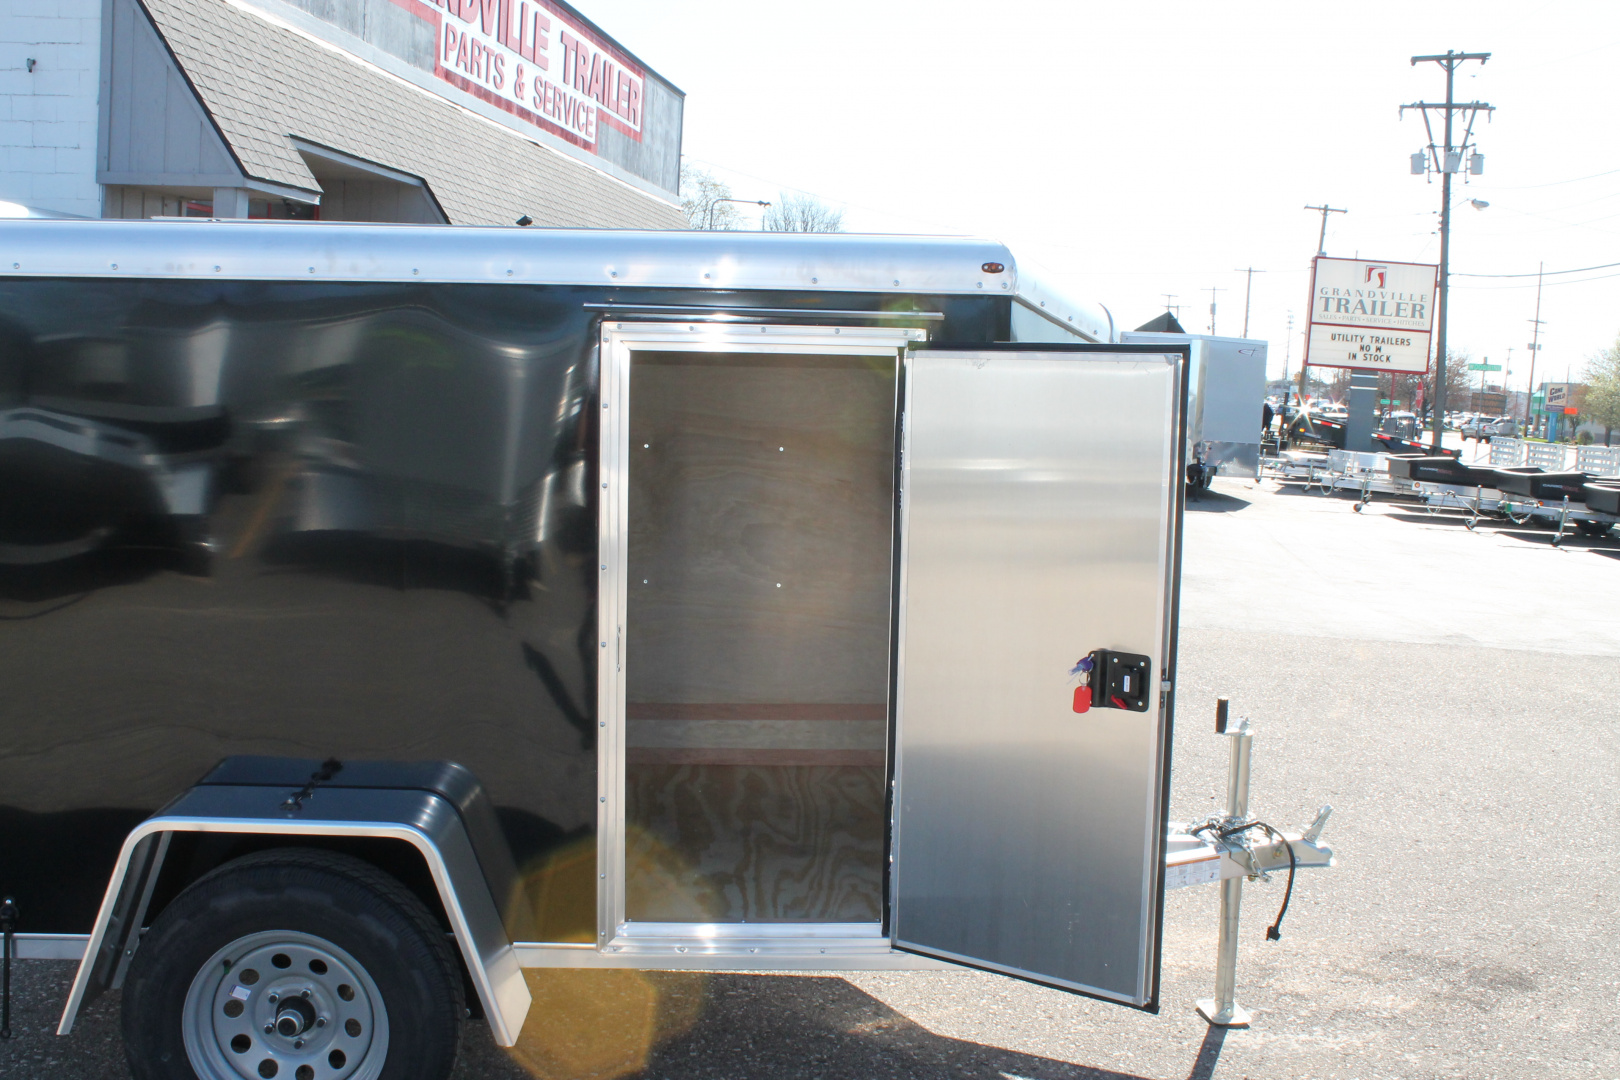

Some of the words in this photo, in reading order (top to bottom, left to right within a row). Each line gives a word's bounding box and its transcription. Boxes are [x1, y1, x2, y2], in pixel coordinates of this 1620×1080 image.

[444, 22, 505, 90] PARTS
[514, 62, 526, 101] &
[533, 75, 595, 138] SERVICE
[561, 30, 641, 126] TRAILER
[1320, 287, 1428, 302] GRANDVILLE
[1320, 296, 1425, 319] TRAILER
[1331, 333, 1365, 342] UTILITY
[1370, 336, 1411, 346] TRAILERS
[1348, 352, 1357, 360] IN
[1363, 353, 1391, 362] STOCK
